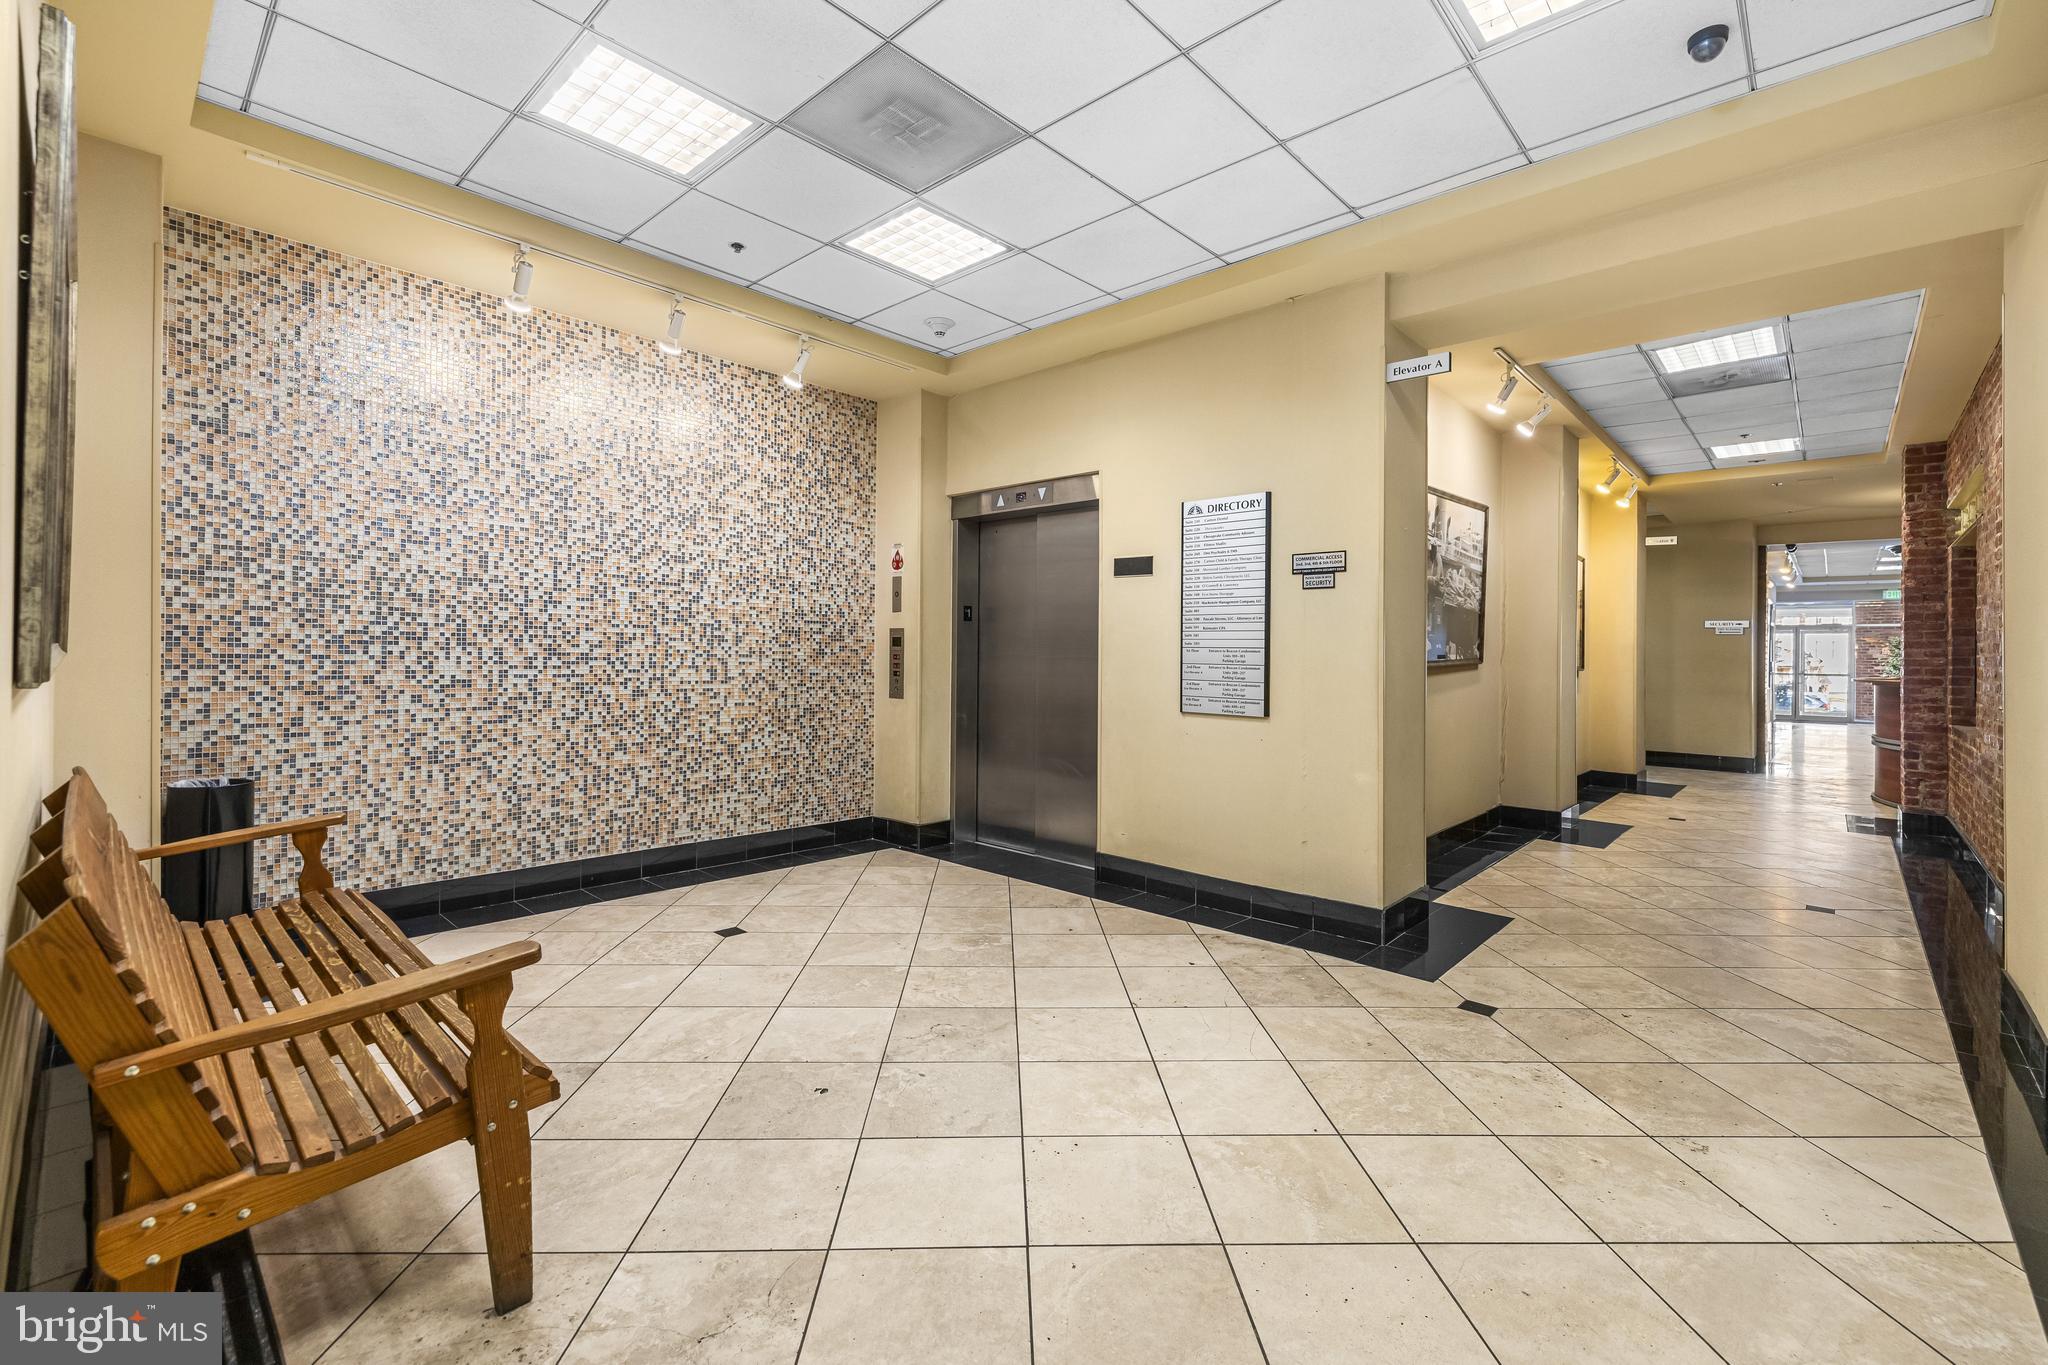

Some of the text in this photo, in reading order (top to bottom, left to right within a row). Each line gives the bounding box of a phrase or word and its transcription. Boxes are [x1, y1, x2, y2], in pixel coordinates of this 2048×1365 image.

[1393, 359, 1443, 376] Elevator A
[1207, 499, 1262, 513] DIRECTORY
